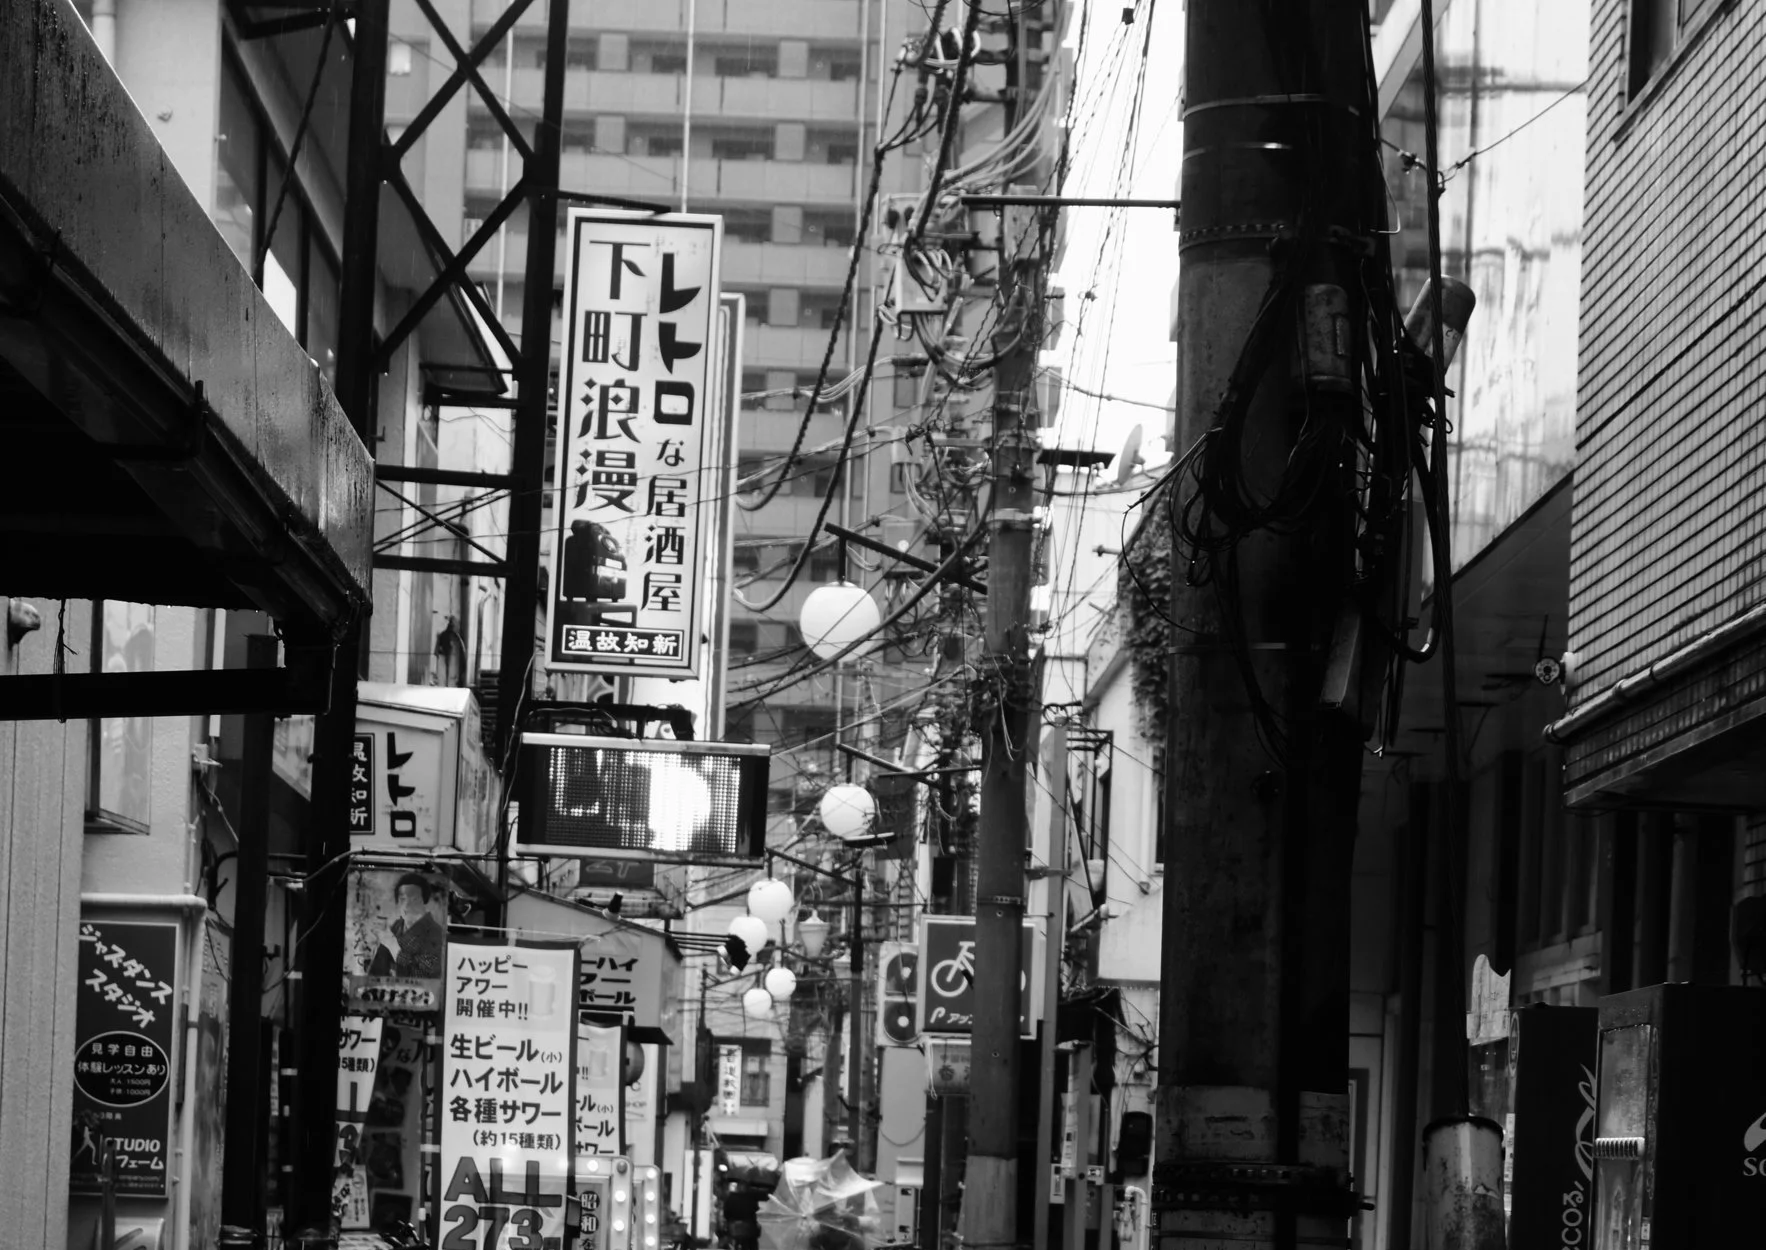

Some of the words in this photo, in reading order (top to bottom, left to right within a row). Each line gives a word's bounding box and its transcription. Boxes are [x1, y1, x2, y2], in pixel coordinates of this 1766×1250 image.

[573, 240, 651, 513] 下町浪漫
[641, 252, 702, 612] レトロな居酒屋
[568, 630, 677, 655] 温故知新
[387, 732, 416, 837] レトロ
[457, 955, 528, 973] ハッピー
[85, 968, 156, 1029] スタジオ
[456, 977, 507, 994] アワー
[456, 1000, 528, 1020] 開催中!!
[91, 1042, 153, 1058] 見学自由
[78, 1061, 166, 1075] 体験レッスンあり
[450, 1067, 563, 1095] ハイボール
[449, 1097, 561, 1125] 各種サワー
[444, 1156, 562, 1208] ALL
